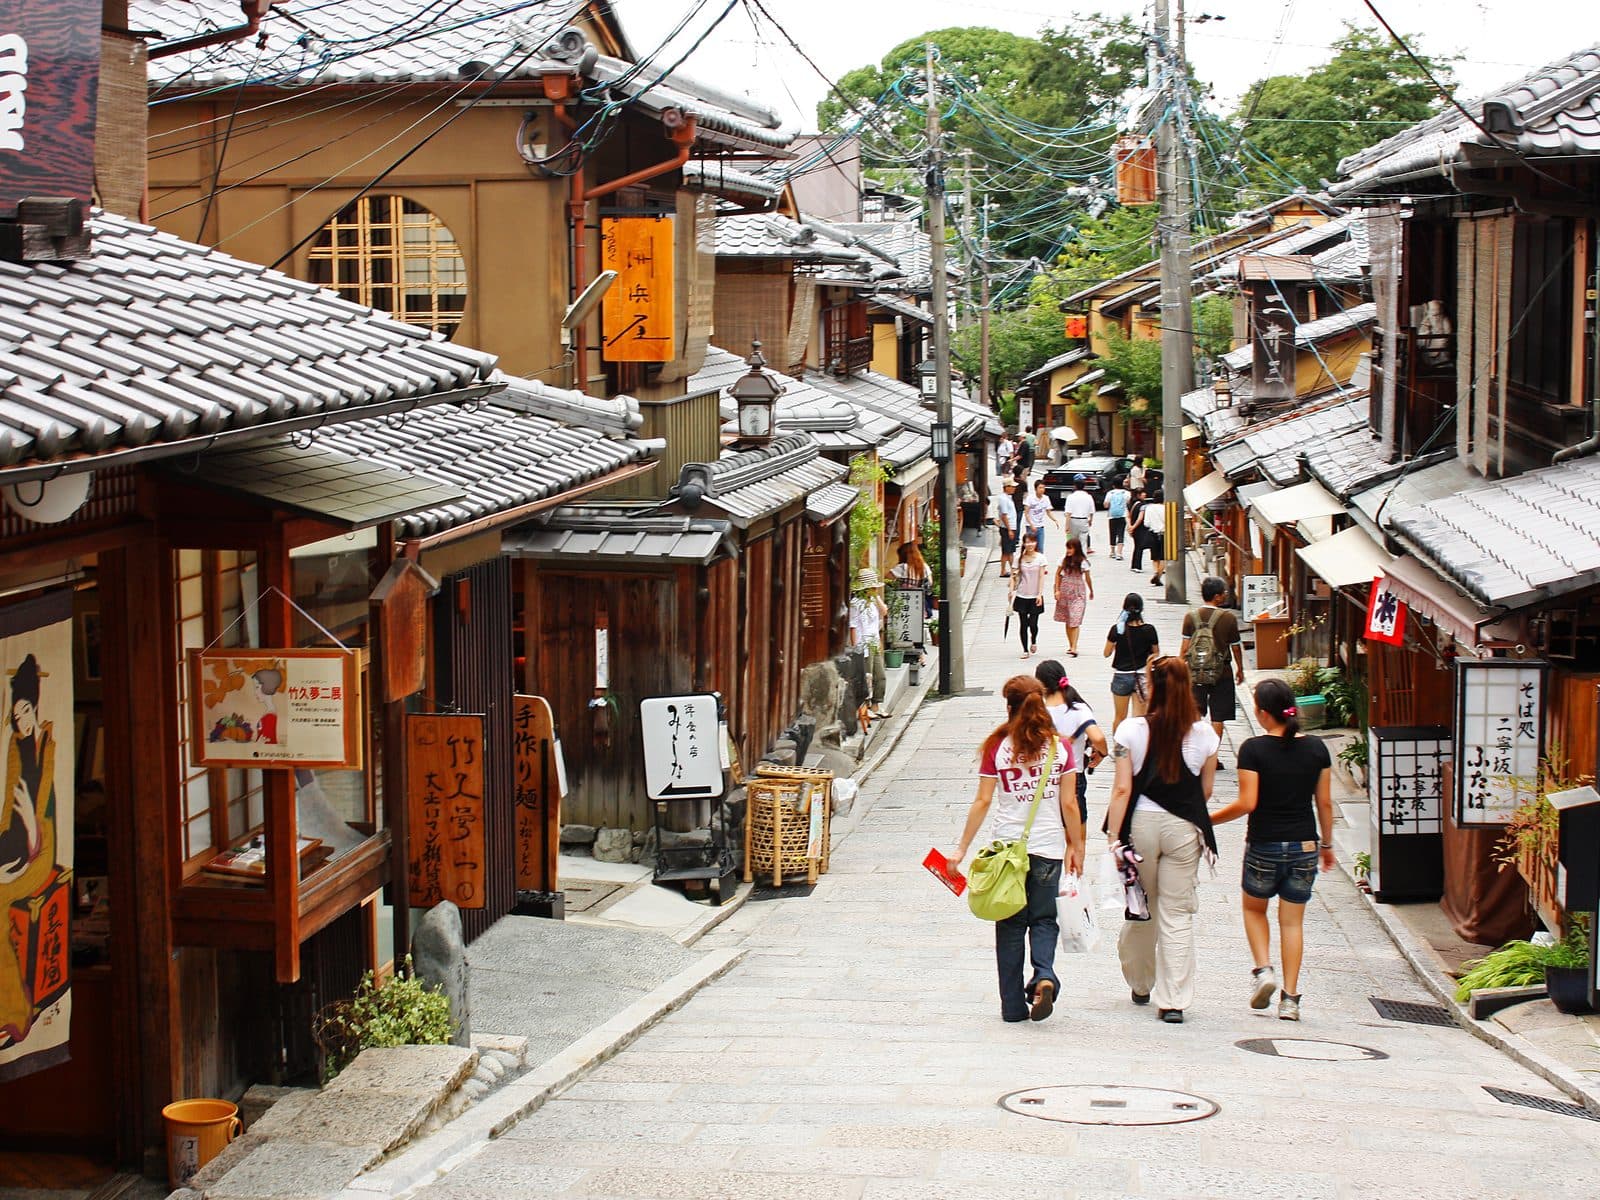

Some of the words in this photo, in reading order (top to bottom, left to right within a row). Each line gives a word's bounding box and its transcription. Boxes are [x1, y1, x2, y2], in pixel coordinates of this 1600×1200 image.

[288, 686, 342, 700] 竹久夢二展
[1518, 681, 1537, 740] そば処
[514, 703, 537, 810] 手作り麺
[1467, 745, 1493, 811] ふたば
[1014, 790, 1056, 802] WOLD
